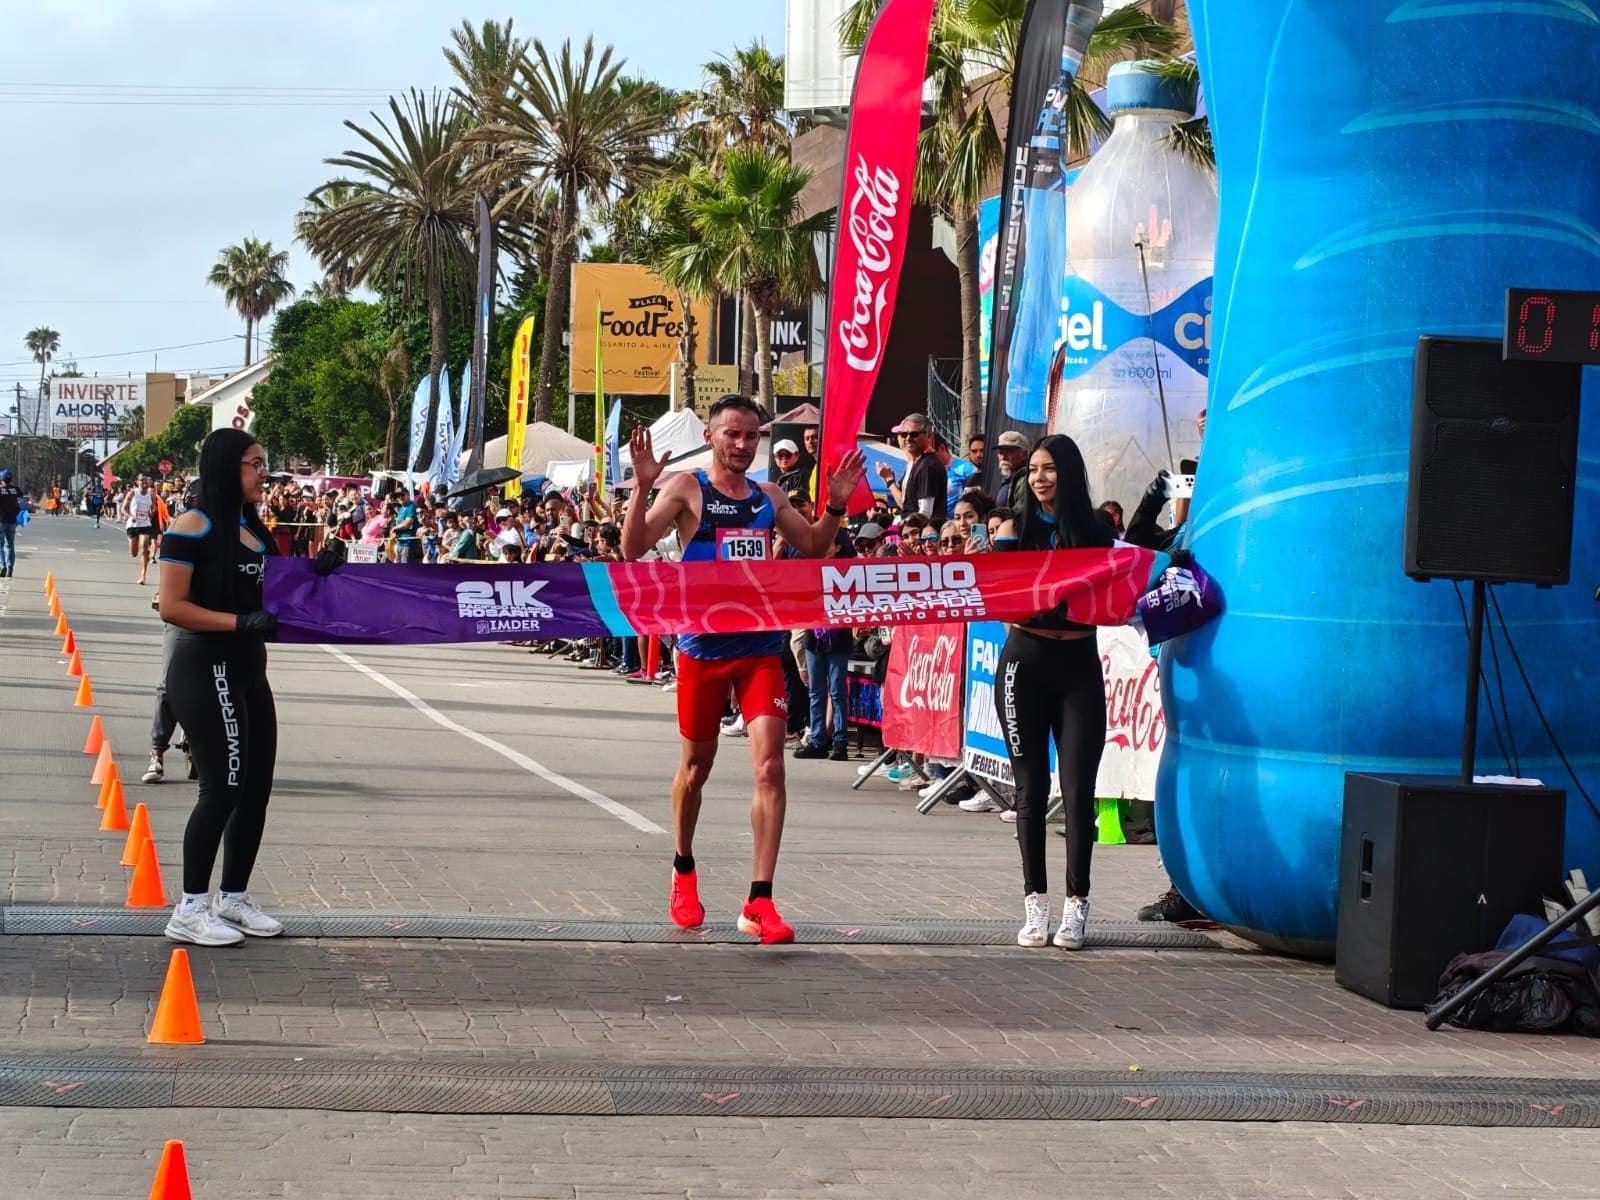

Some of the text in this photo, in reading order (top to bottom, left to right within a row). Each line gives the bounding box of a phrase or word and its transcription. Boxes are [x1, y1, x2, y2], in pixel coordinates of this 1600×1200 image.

[839, 152, 899, 371] Coca-Cola
[635, 296, 662, 307] PLAZA
[770, 321, 807, 345] INK.
[1054, 297, 1104, 351] iel
[1174, 296, 1212, 350] ci
[59, 383, 138, 400] INVIERTE
[56, 402, 117, 417] AHORA
[728, 539, 763, 558] 1539
[821, 561, 976, 593] MEDIO
[455, 580, 551, 608] 21K
[823, 588, 982, 611] MARATON
[460, 609, 554, 618] ROSARITO
[826, 596, 985, 618] POWERADE
[829, 608, 987, 624] ROSARITO 2025
[490, 620, 540, 631] IMDER
[1005, 663, 1023, 757] POWERADE
[213, 664, 240, 786] POWERADE
